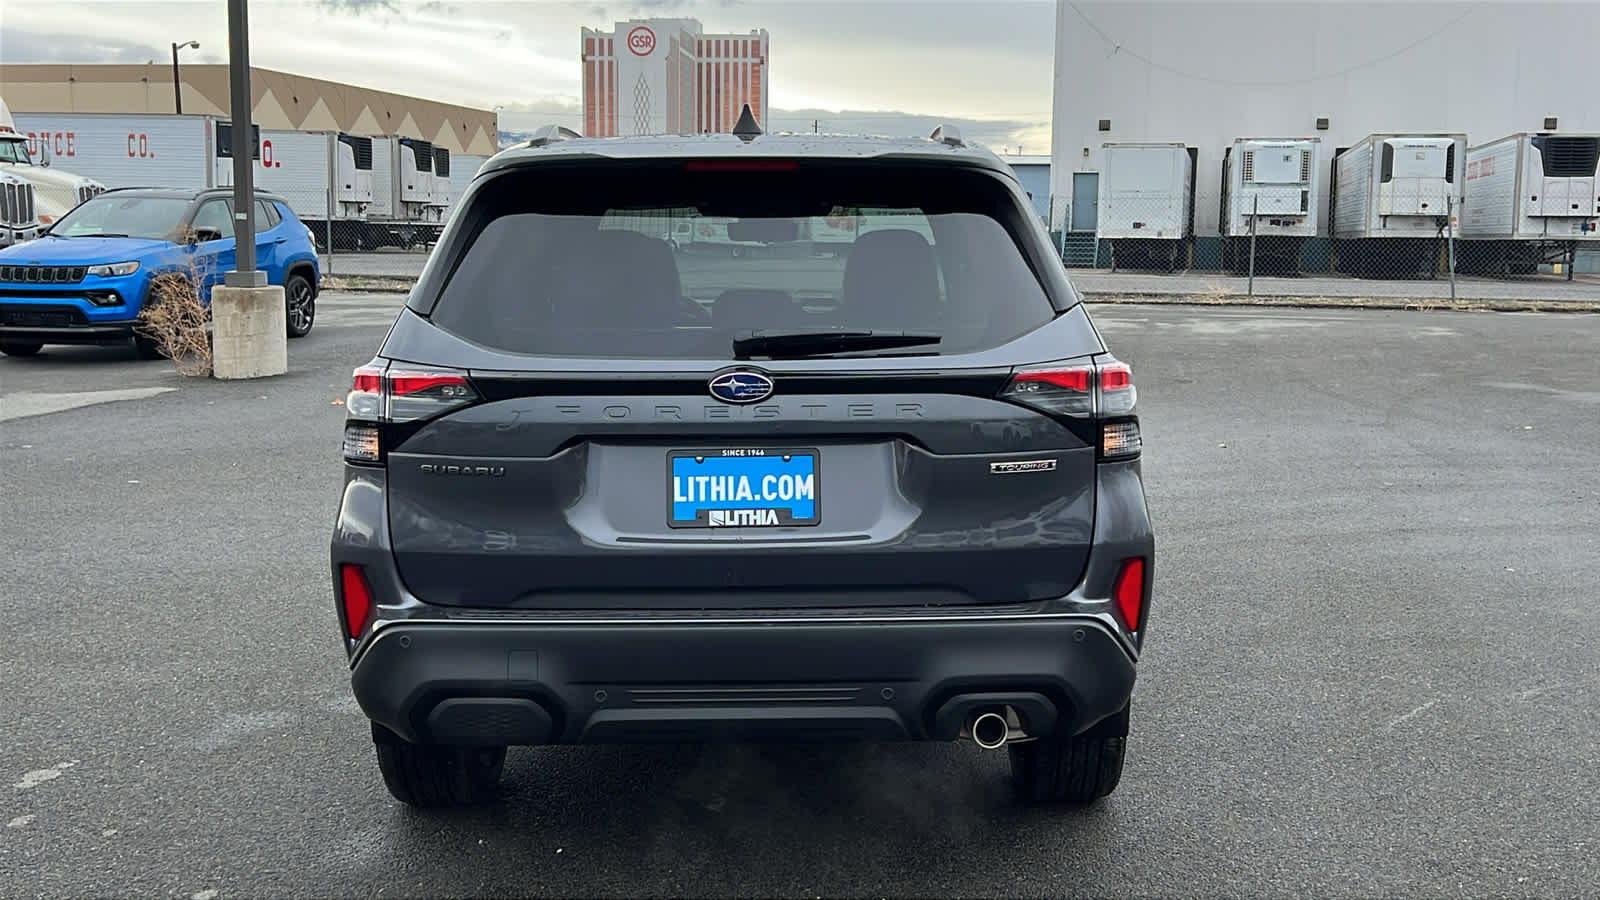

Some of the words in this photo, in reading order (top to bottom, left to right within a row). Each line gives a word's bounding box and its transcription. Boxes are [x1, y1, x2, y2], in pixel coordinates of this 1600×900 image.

[631, 35, 652, 48] GSR
[128, 134, 155, 158] CO.
[555, 403, 923, 419] FORESTER
[420, 464, 505, 477] SUBARU
[1000, 462, 1049, 472] TOURING
[673, 474, 815, 502] LITHIA.COM
[725, 509, 779, 526] LITHIA
